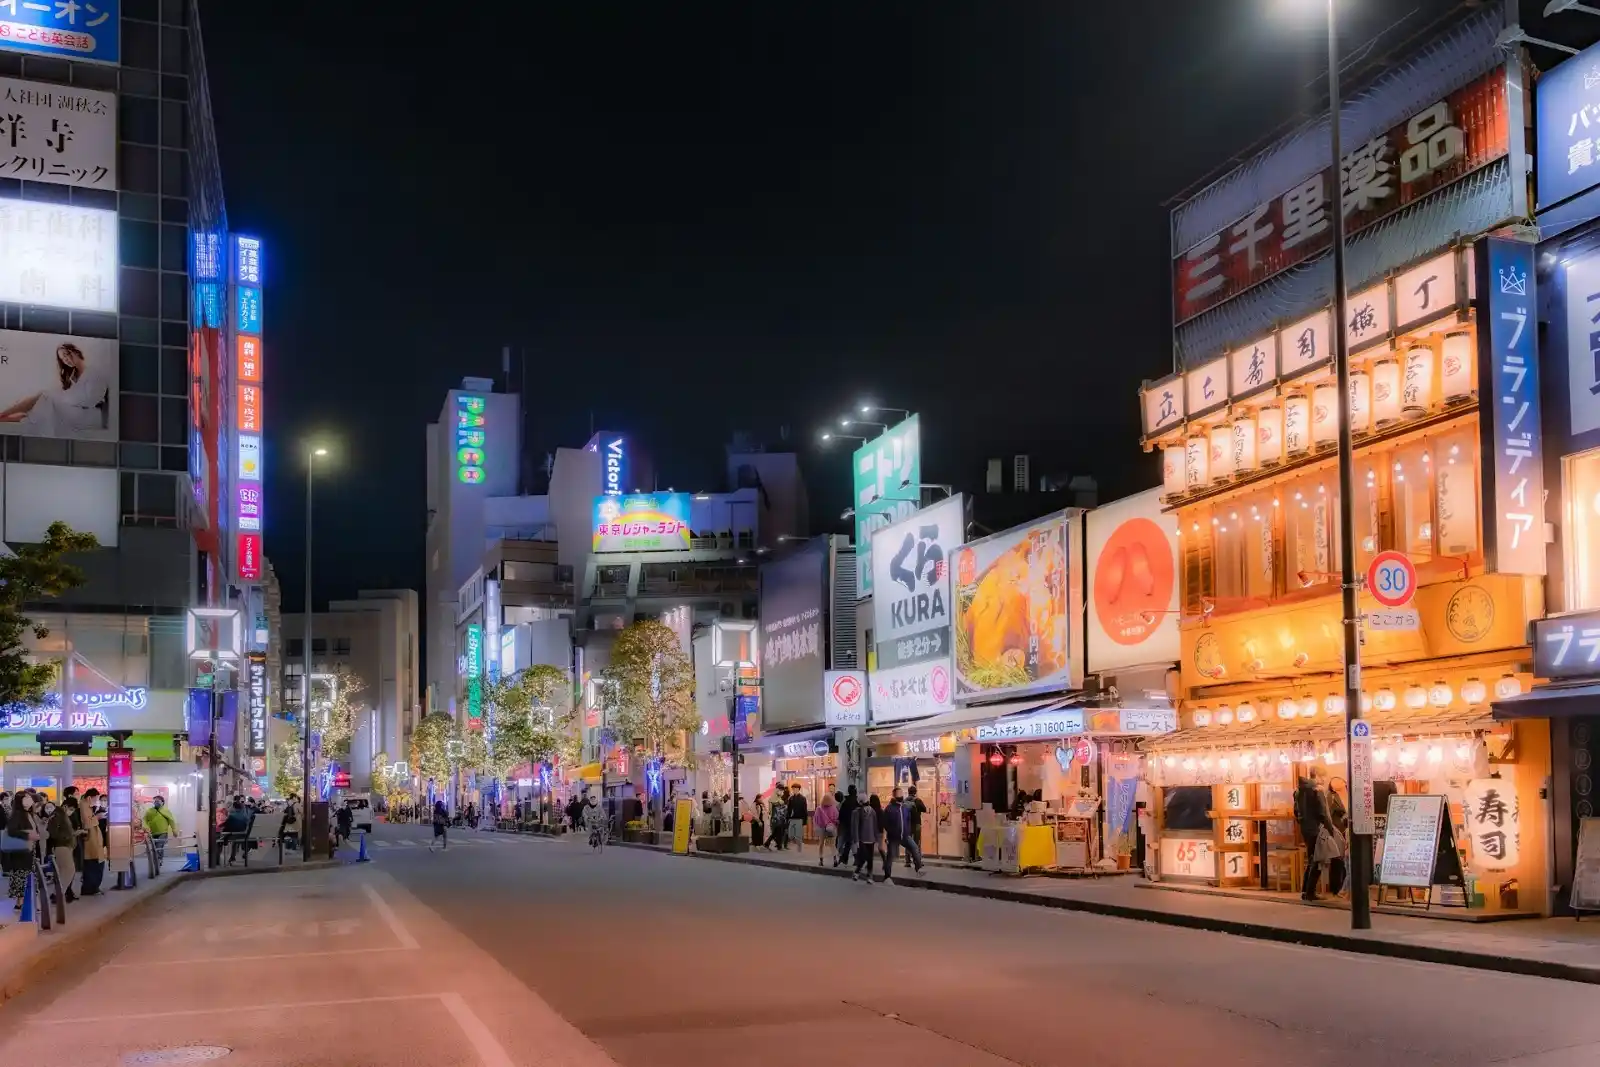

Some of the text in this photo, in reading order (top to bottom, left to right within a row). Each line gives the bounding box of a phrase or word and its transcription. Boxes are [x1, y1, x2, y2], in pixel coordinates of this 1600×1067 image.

[17, 28, 89, 49] こども英会話
[1186, 100, 1466, 302] 三千里薬品
[457, 395, 486, 484] PARCO
[1501, 306, 1534, 550] ブランディア
[859, 428, 917, 508] ニトリ
[1379, 568, 1405, 591] 30
[892, 588, 945, 629] KURA
[1372, 613, 1416, 626] ここから
[979, 725, 1026, 738] ローストチキン
[1475, 788, 1509, 861] 寿司
[1177, 841, 1197, 862] 65
